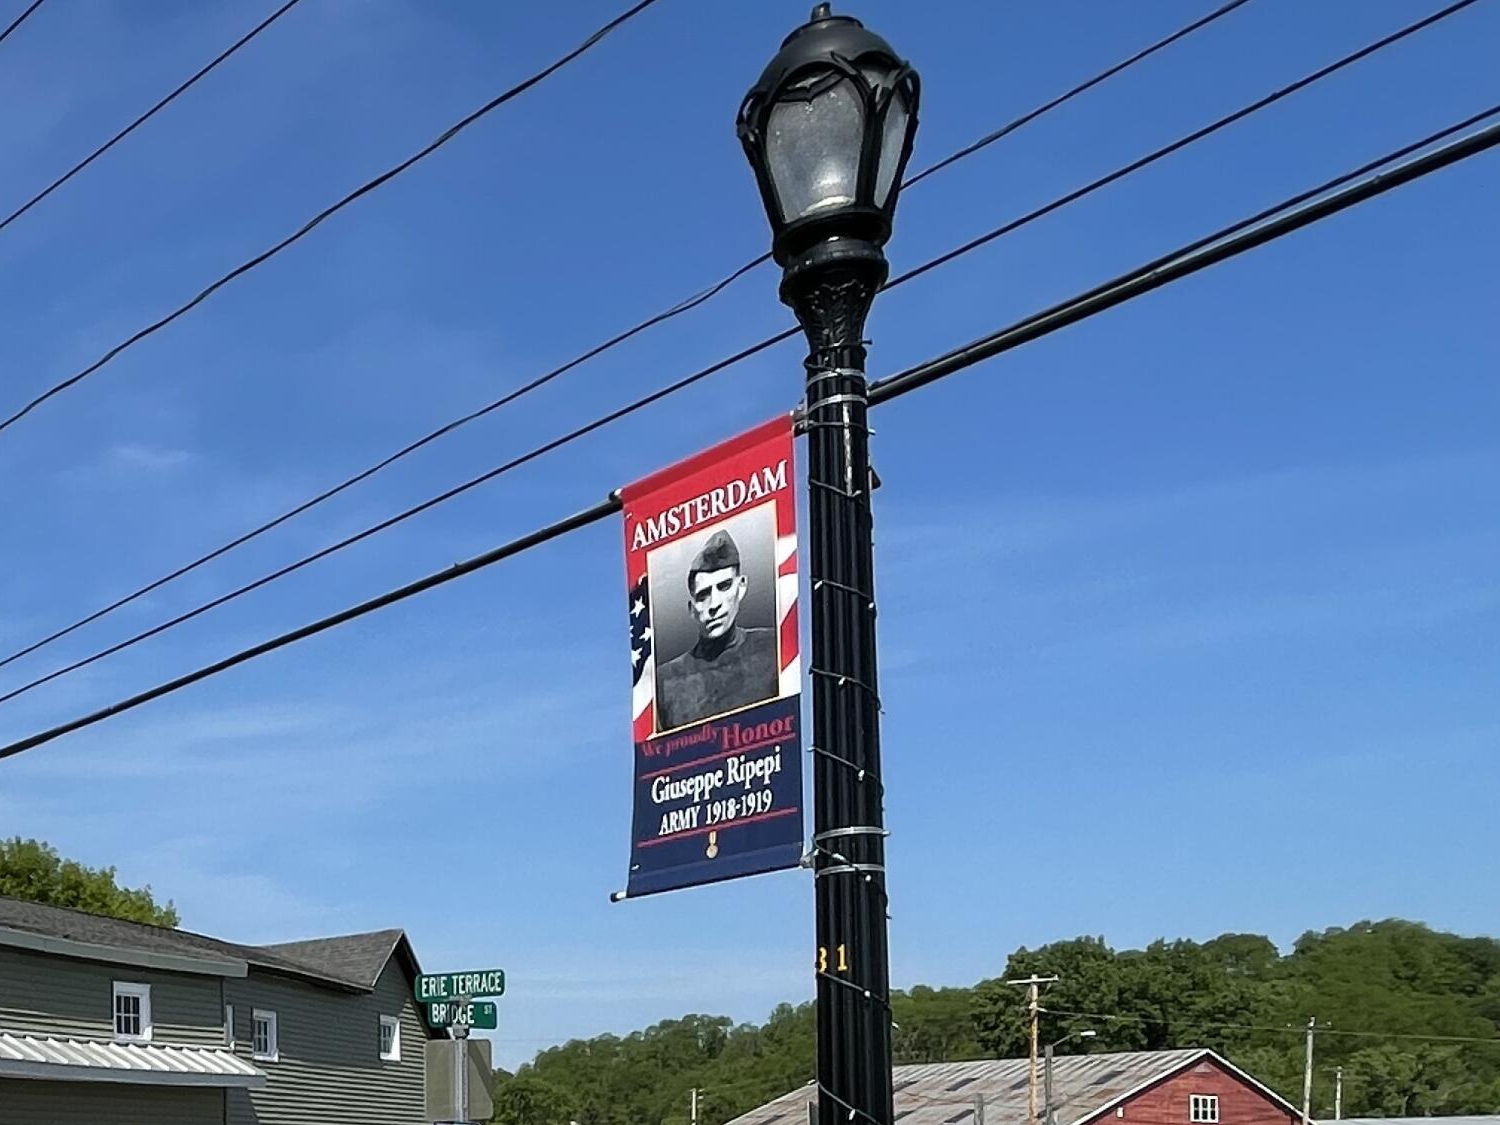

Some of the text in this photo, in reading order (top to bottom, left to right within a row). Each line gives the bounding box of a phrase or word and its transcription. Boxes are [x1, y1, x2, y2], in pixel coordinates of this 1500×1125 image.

[631, 459, 788, 552] AMSTERDAM
[665, 723, 718, 757] proudly
[721, 715, 795, 750] Honor
[651, 745, 782, 804] Giuseppe Ripepi
[658, 789, 773, 836] ARMY 1918-1919
[421, 972, 502, 998] ERIE TERRACE
[431, 1003, 475, 1024] BRIDGE
